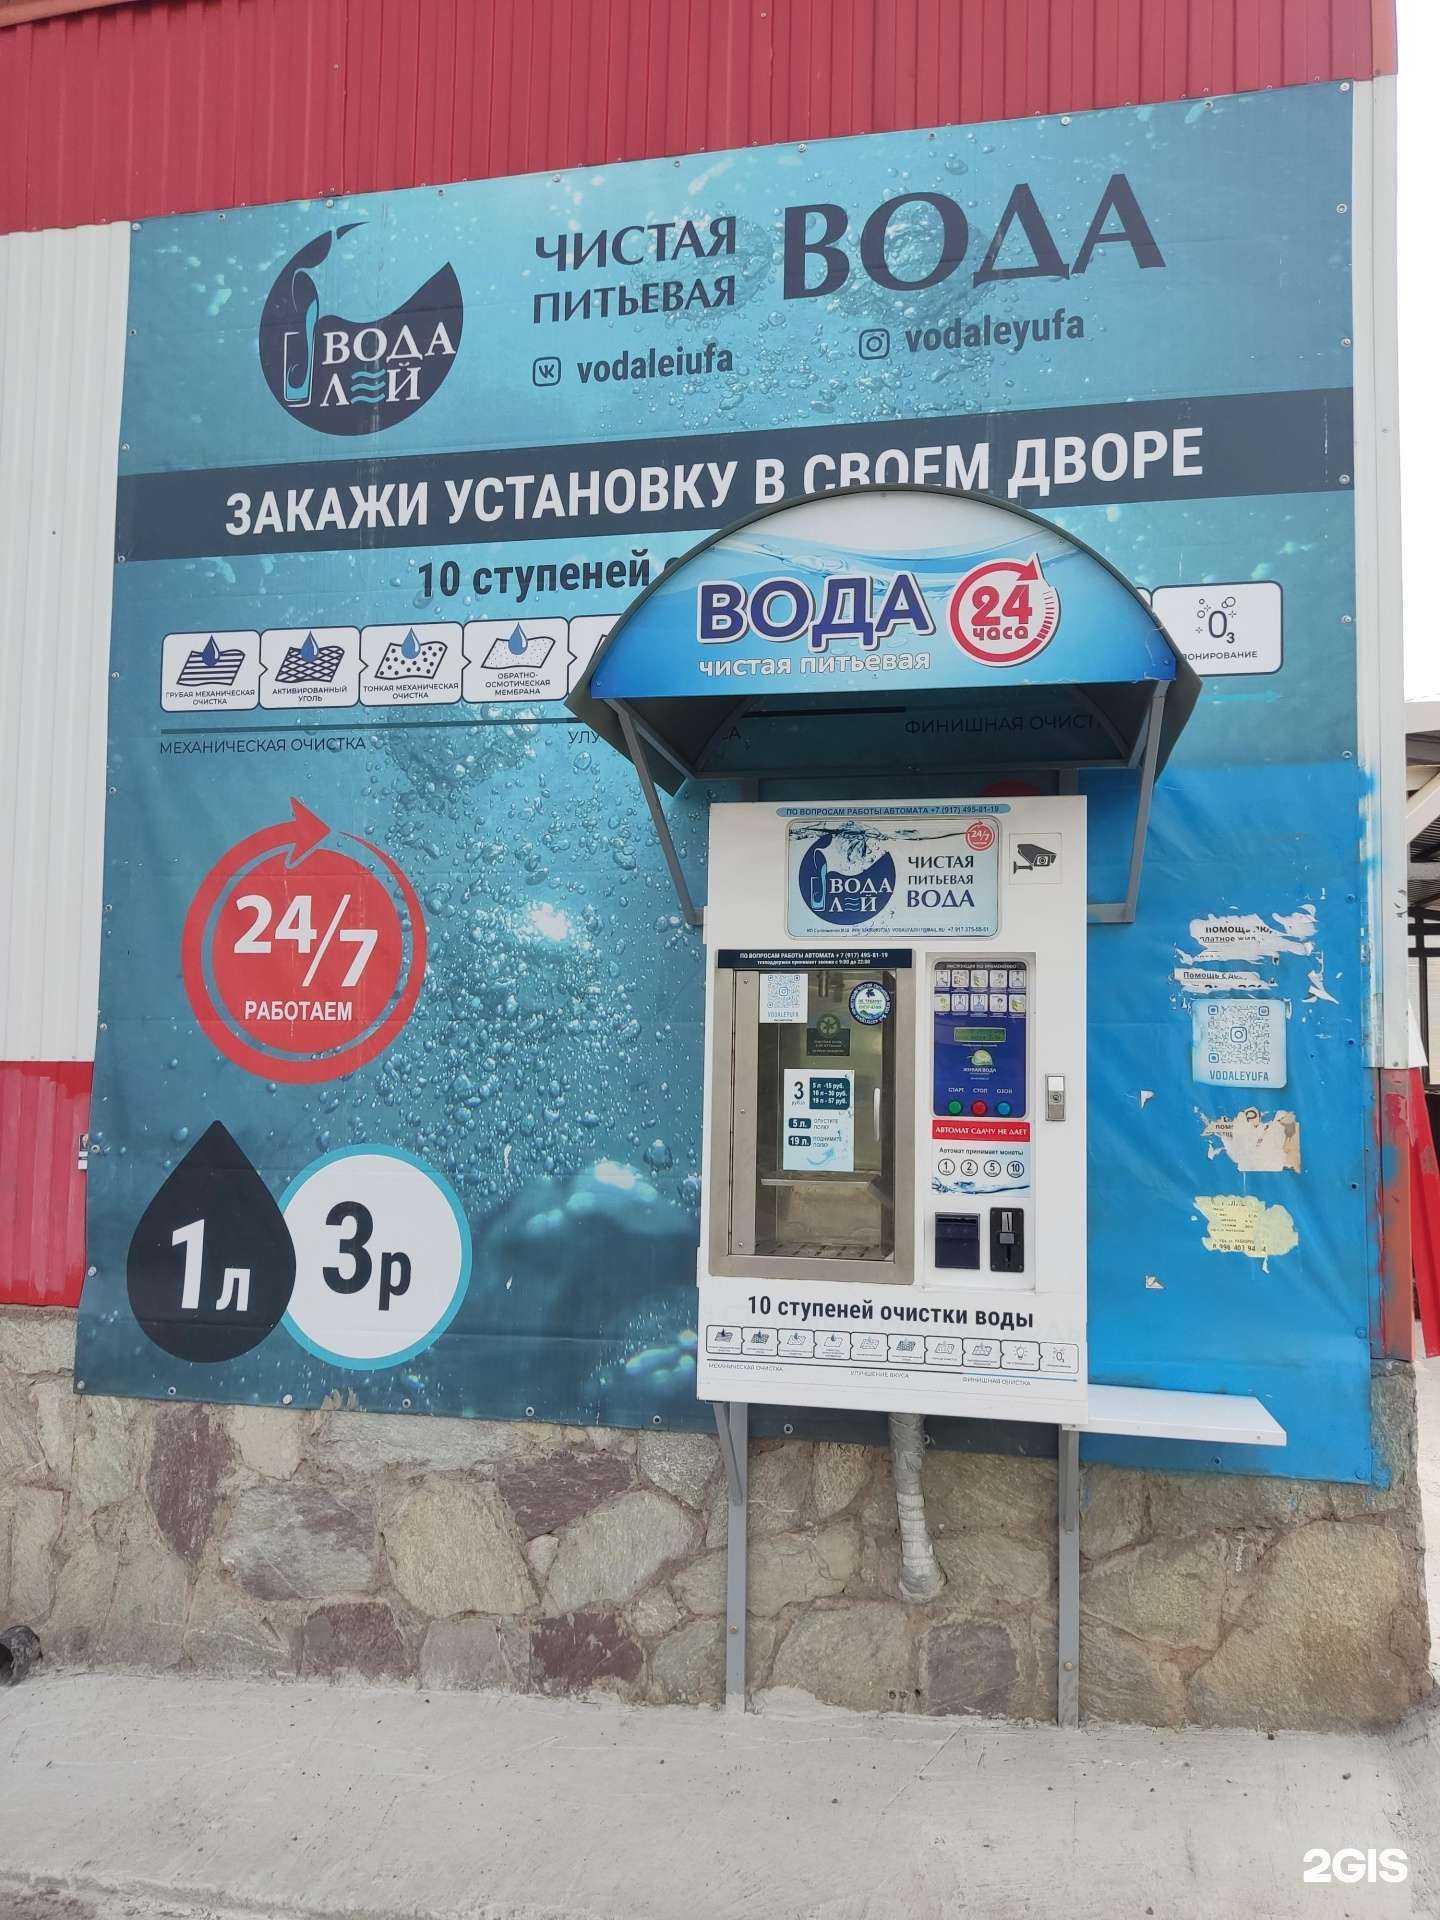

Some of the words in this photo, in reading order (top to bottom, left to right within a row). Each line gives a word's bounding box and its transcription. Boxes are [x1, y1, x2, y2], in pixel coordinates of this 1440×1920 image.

[535, 216, 736, 272] ЧИСТАЯ
[783, 173, 1166, 300] ВОДА
[533, 275, 736, 324] ПИТЬЕВАЯ
[905, 308, 1085, 354] vodaleyufa
[322, 321, 456, 366] ВОДА
[577, 344, 734, 386] vodaleiufa
[225, 481, 428, 537] ЗАКАЖИ
[444, 460, 740, 524] УСТАНОВКУ
[755, 458, 785, 505] В
[803, 442, 990, 494] СВОЕМ
[1007, 427, 1204, 499] ДВОРЕ
[418, 560, 461, 597] 10
[472, 549, 650, 603] ступеней
[699, 572, 933, 650] ВОДА
[970, 584, 1033, 627] 24
[699, 657, 792, 678] чистая
[800, 651, 932, 674] питьевая
[485, 679, 551, 689] ОСМОТИЧЕСКАЯ
[497, 671, 538, 680] ОБРАТНО-
[165, 690, 193, 698] ГРУБАЯ
[195, 688, 255, 698] МЕХАНИЧЕСКАЯ
[271, 685, 348, 695] АКТИВИРОВАННЫЙ
[363, 685, 394, 693] ТОНКАЯ
[396, 682, 459, 691] МЕХАНИЧЕСКАЯ
[392, 691, 429, 700] ОЧИСТКА
[494, 687, 541, 696] МЕМБРАНА
[192, 698, 228, 706] ОЧИСТКА
[298, 695, 323, 703] УГОЛЬ
[904, 715, 1024, 735] ФИНИШНАЯ
[1029, 713, 1097, 731] ОЧИСТ
[160, 739, 286, 754] МЕХАНИЧЕСКАЯ
[290, 737, 366, 751] ОЧИСТКА
[568, 730, 600, 744] УЛУ
[847, 807, 882, 815] РАБОТЫ
[884, 807, 929, 815] АВТОМАТА
[908, 855, 974, 869] ЧИСТАЯ
[828, 877, 893, 895] ВОДА
[908, 874, 974, 885] ПИТЬЕВАЯ
[906, 889, 975, 908] ВОДА
[233, 893, 378, 987] 24/7
[1183, 971, 1220, 980] Помощь
[244, 1000, 353, 1022] РАБОТАЕМ
[1209, 1069, 1269, 1082] VODALEYUFA
[793, 1081, 804, 1100] 3
[792, 1120, 798, 1128] 5
[935, 1126, 969, 1134] АВТОМАТ
[971, 1127, 996, 1135] СДАЧУ
[998, 1128, 1007, 1136] НЕ
[790, 1137, 800, 1145] 19
[939, 1146, 964, 1154] Автомат
[965, 1148, 998, 1156] принимает
[966, 1161, 973, 1171] 2
[1011, 1163, 1020, 1173] 10
[321, 1200, 374, 1295] 3
[379, 1250, 412, 1312] р
[170, 1218, 205, 1311] 1
[215, 1266, 251, 1312] л
[748, 1296, 771, 1315] 10
[778, 1300, 874, 1321] ступеней
[880, 1305, 968, 1325] очистки
[975, 1310, 1034, 1331] воды
